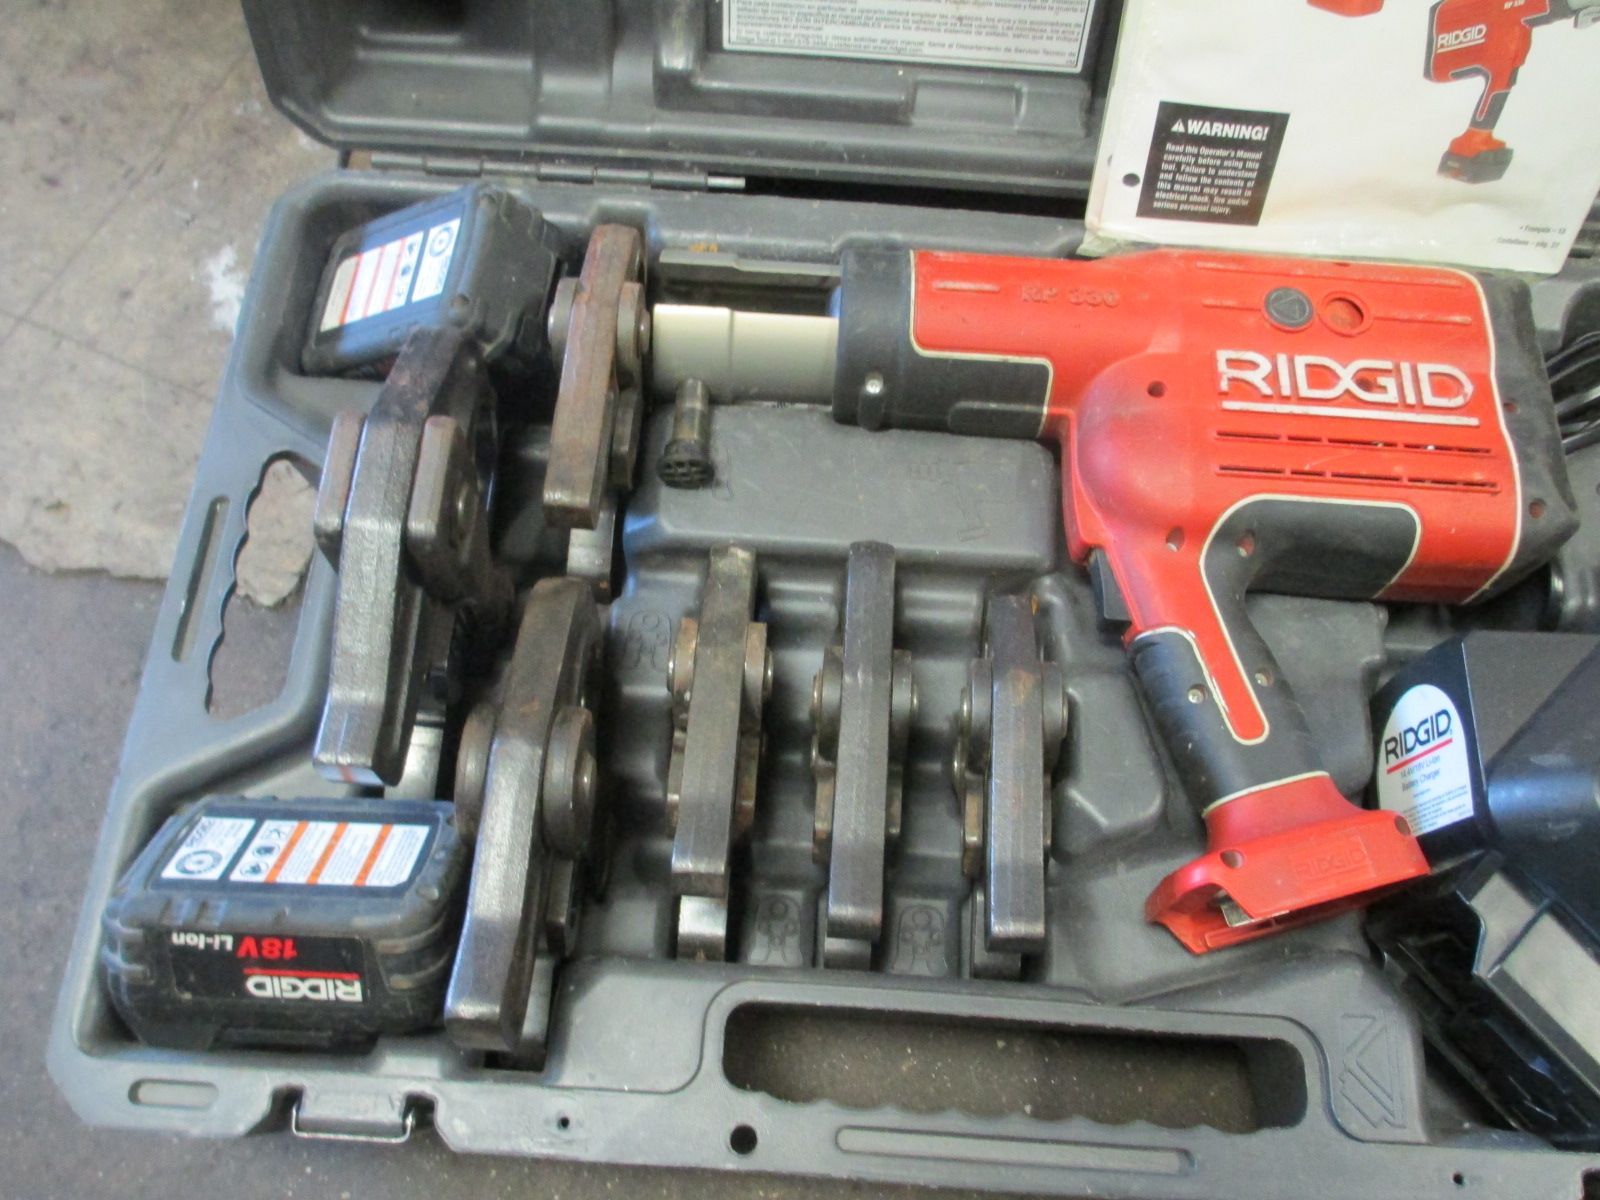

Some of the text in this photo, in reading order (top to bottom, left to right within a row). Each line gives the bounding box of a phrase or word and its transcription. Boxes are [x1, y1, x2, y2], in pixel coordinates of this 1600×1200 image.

[1437, 24, 1487, 49] RIDGID
[1187, 119, 1269, 141] WARNING!
[1165, 143, 1262, 160] Read this Operator's Manual
[1161, 161, 1257, 180] tool. Failure to understand
[1163, 153, 1259, 170] carefully before using this
[1157, 181, 1252, 197] this manual may result in
[1159, 171, 1255, 188] and follow the contents of
[1153, 200, 1178, 210] serious
[1179, 202, 1209, 213] personal
[1155, 190, 1188, 202] electrical
[1213, 196, 1225, 205] fire
[1227, 197, 1249, 207] and/or
[1216, 349, 1475, 408] RIDGID
[1384, 708, 1452, 765] RIDGID
[171, 931, 298, 960] 18V Li-Ion
[246, 975, 363, 1002] RIDGID
